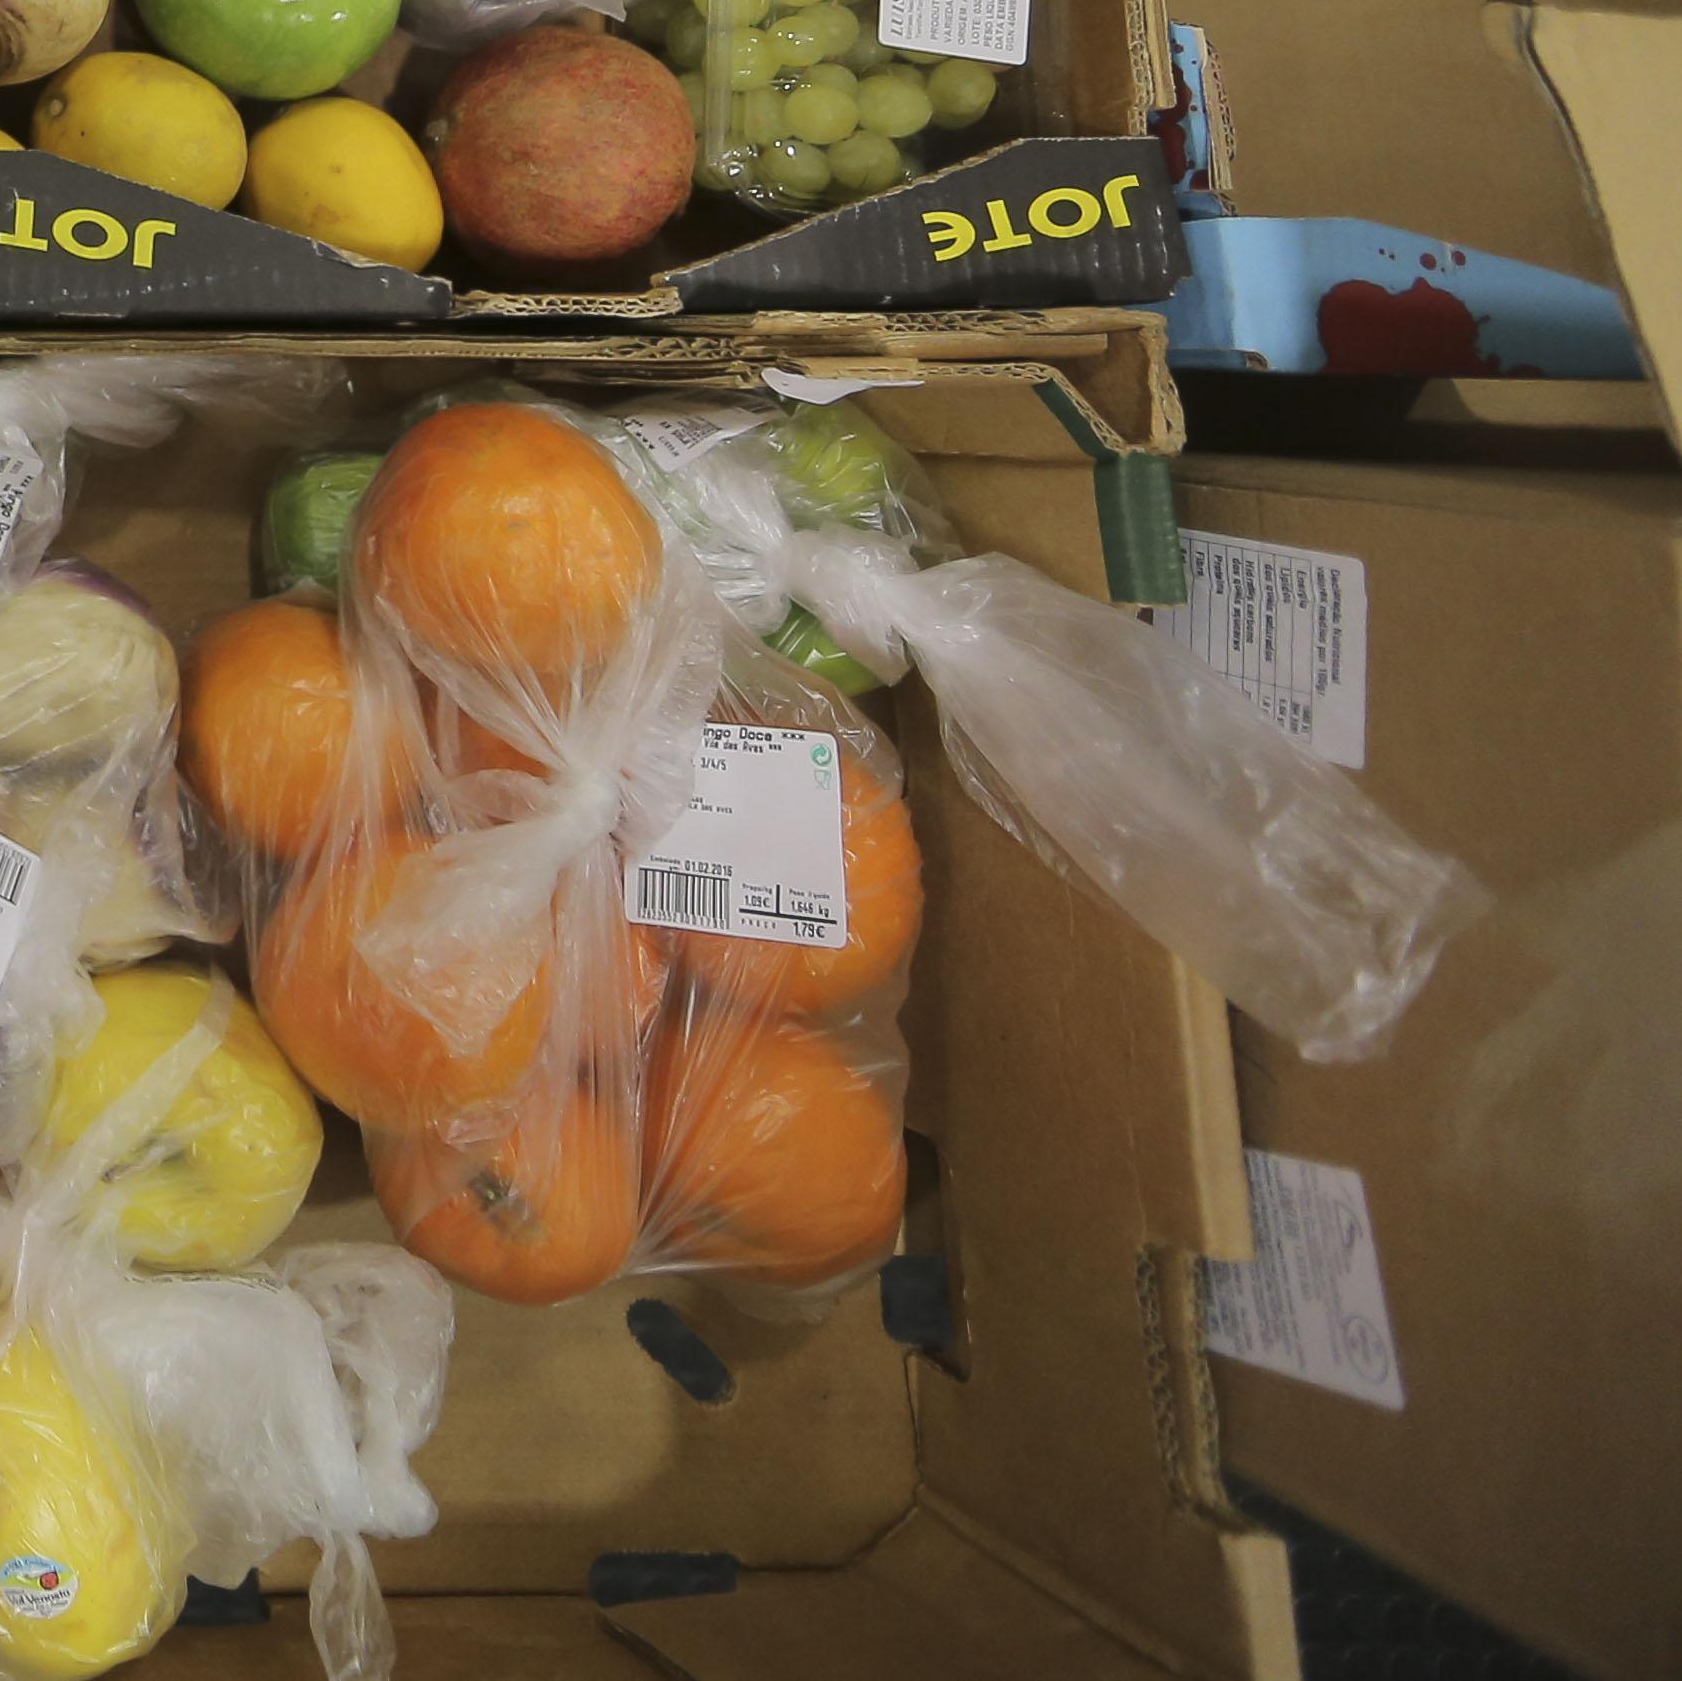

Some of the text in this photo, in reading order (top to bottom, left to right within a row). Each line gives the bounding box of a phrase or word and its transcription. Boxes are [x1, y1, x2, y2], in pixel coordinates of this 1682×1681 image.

[983, 21, 994, 48] PESO
[994, 22, 1005, 50] DATA
[922, 173, 1140, 263] JOTE
[0, 489, 23, 518] Pingo
[702, 725, 774, 742] ingo Doce
[700, 757, 727, 771] 3/4/5
